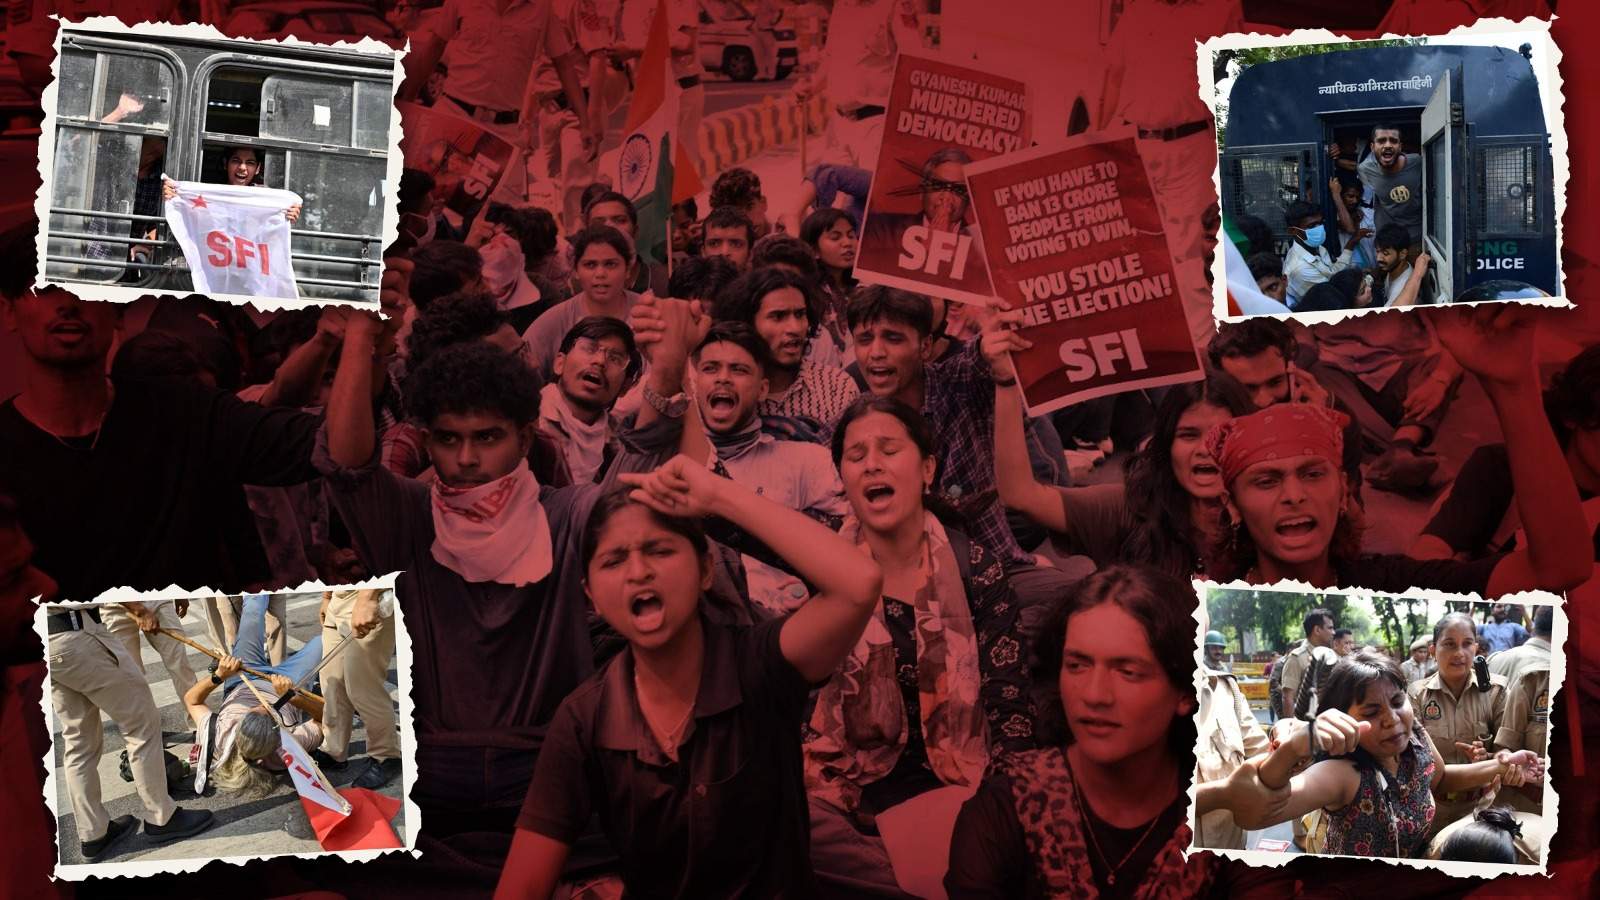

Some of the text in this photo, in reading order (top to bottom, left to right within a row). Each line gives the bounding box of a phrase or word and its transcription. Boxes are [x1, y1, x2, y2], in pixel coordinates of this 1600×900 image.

[910, 70, 977, 97] GYANESH
[897, 111, 1023, 153] DEMOCRACY!
[910, 88, 1021, 132] MURDERED
[464, 152, 500, 199] SFI
[994, 161, 1118, 207] IF YOU HAVE TO
[1004, 180, 1120, 224] BAN 13 CRORE
[1008, 198, 1124, 243] PEOPLE FROM
[207, 231, 269, 275] SFI
[898, 225, 972, 280] SFI
[1005, 219, 1137, 264] VOTING TO WIN,
[1476, 257, 1525, 270] OLICE
[1018, 253, 1143, 302] YOU STOLE
[1051, 273, 1173, 321] ELECTION!
[1058, 328, 1148, 383] SFI
